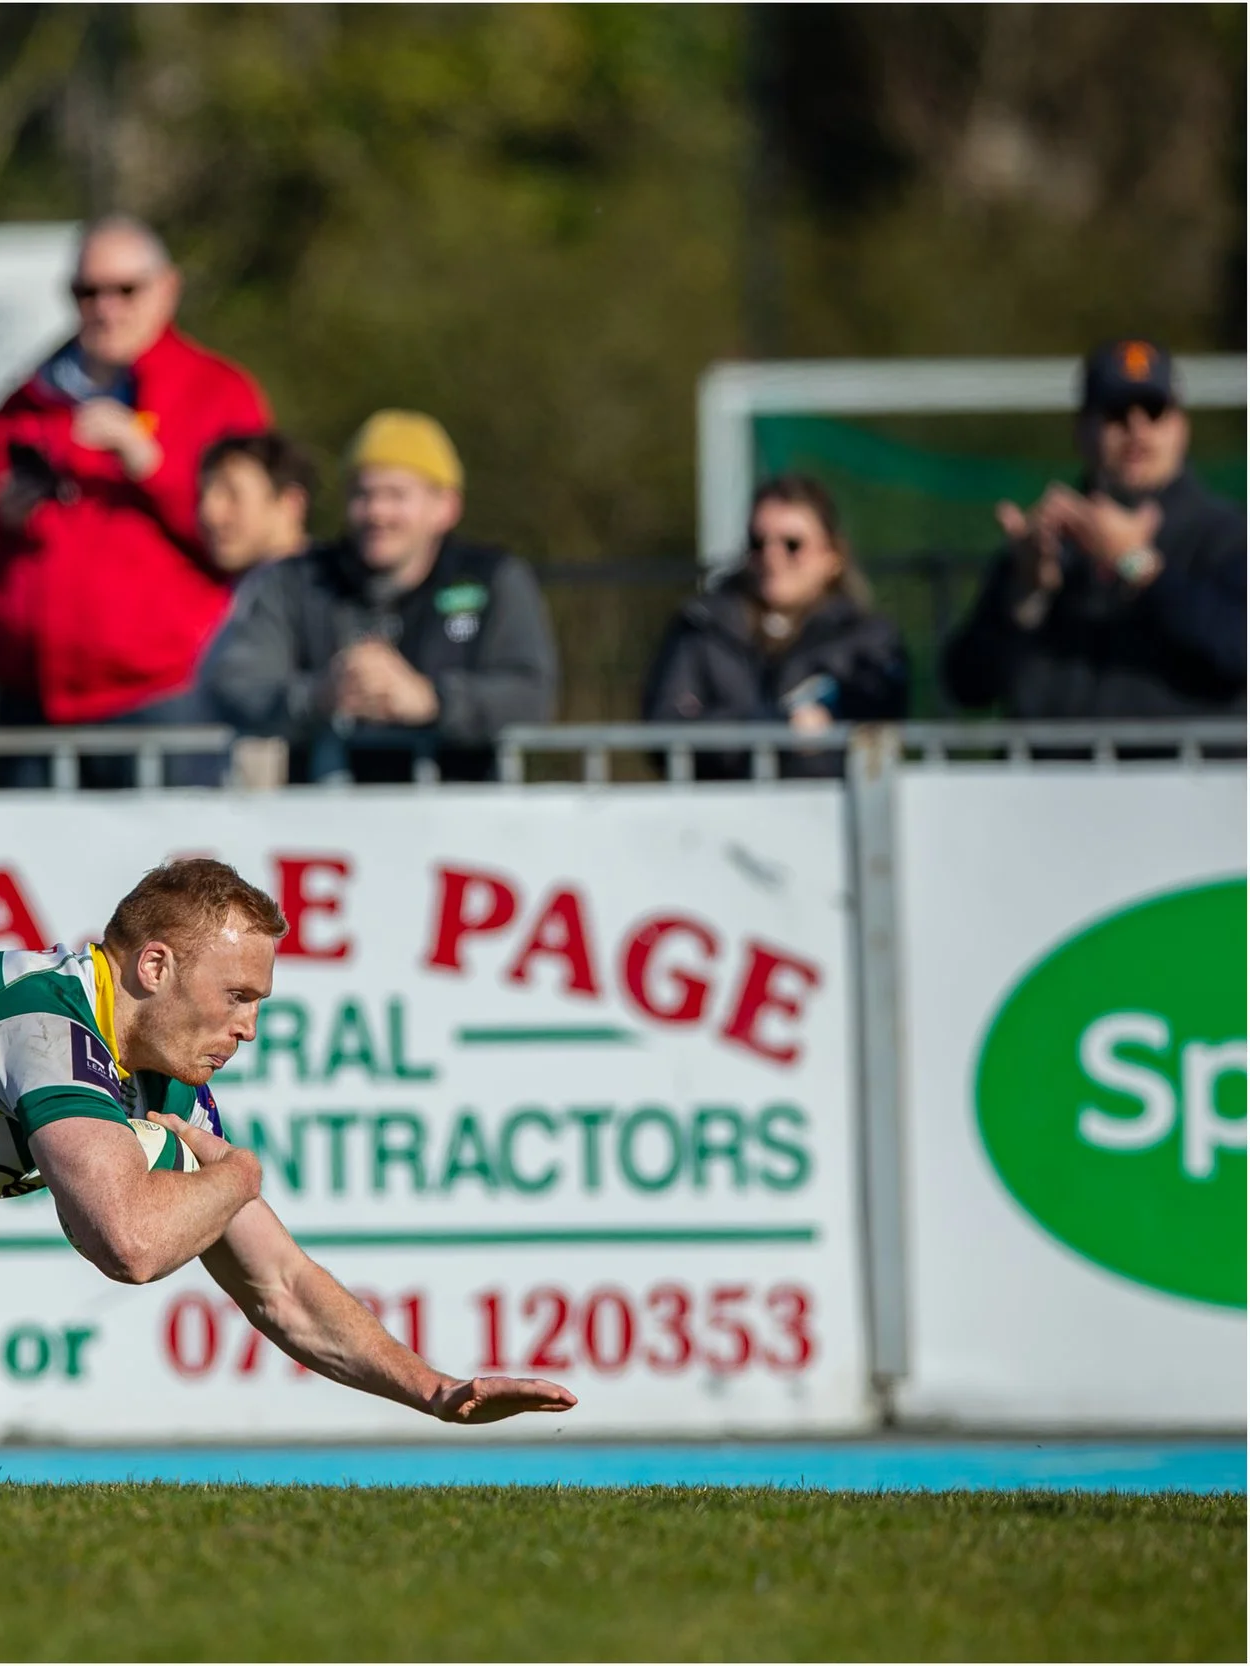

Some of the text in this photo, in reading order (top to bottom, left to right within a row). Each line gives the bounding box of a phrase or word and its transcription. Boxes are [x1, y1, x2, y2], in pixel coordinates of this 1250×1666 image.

[424, 858, 821, 1068] PAGE
[210, 993, 438, 1085] RAL
[242, 1103, 815, 1194] NTRACTORS
[0, 1322, 96, 1381] or
[472, 1283, 816, 1373] 120353
